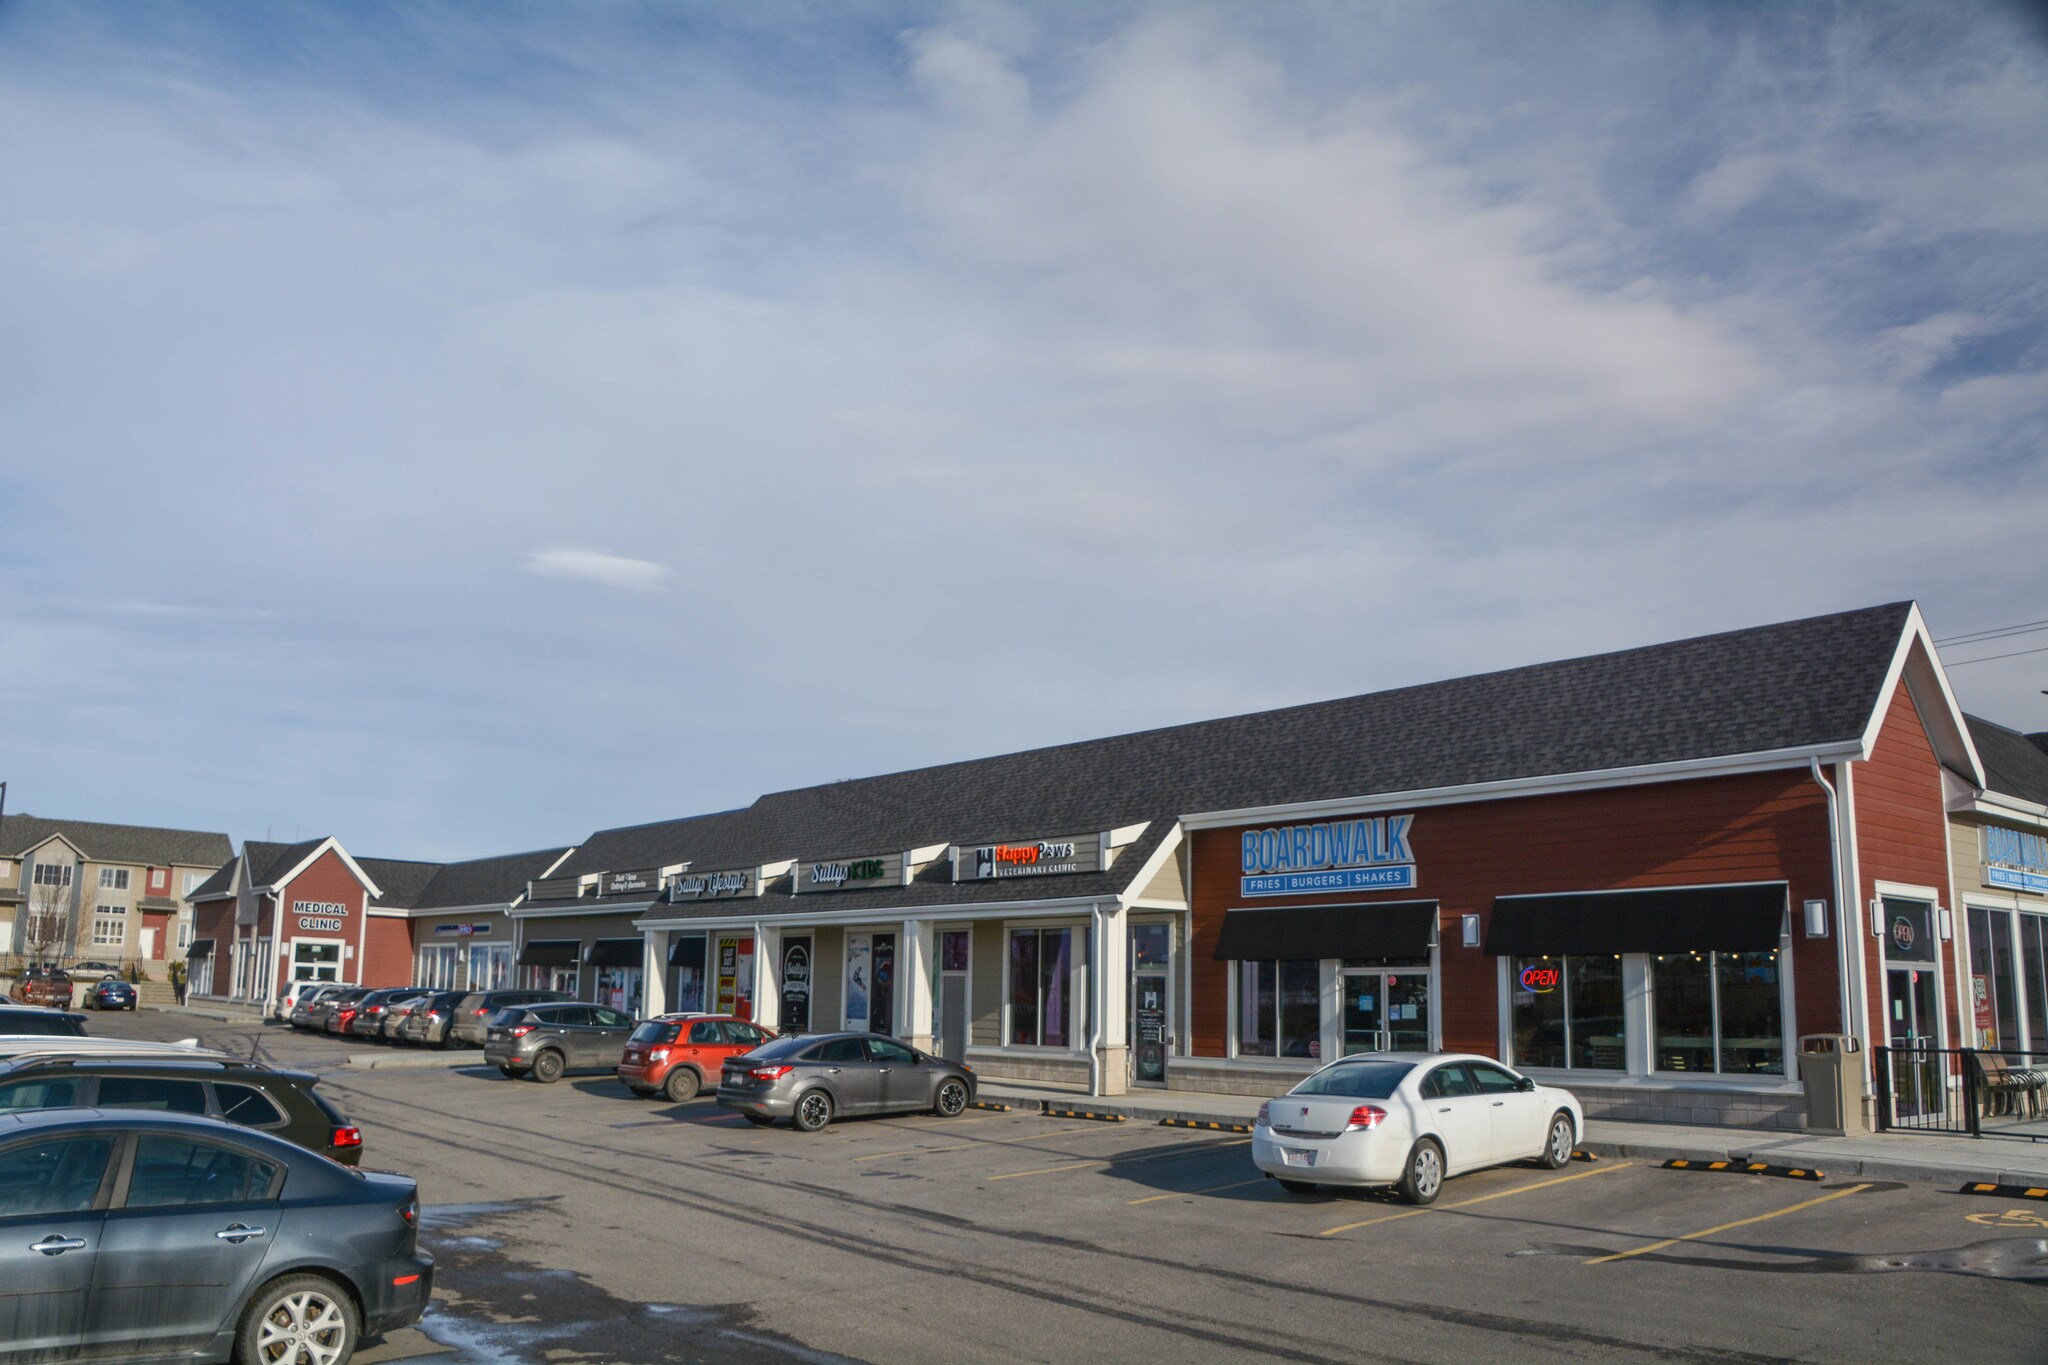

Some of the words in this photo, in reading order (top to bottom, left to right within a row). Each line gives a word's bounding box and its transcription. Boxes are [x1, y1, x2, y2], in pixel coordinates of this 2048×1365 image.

[1242, 815, 1414, 875] BOARDWALK
[851, 859, 884, 880] KIDS
[999, 865, 1047, 876] VETERINARY
[1049, 863, 1077, 873] CLINIC
[708, 872, 747, 896] Lifestyle
[1250, 879, 1280, 890] FRIES
[1291, 875, 1343, 888] BURGERS
[1355, 871, 1401, 884] SHAKES
[294, 901, 348, 916] MEDICAL
[300, 917, 341, 931] CLINIC
[1895, 923, 1912, 944] OPEN
[1522, 969, 1559, 985] OPEN
